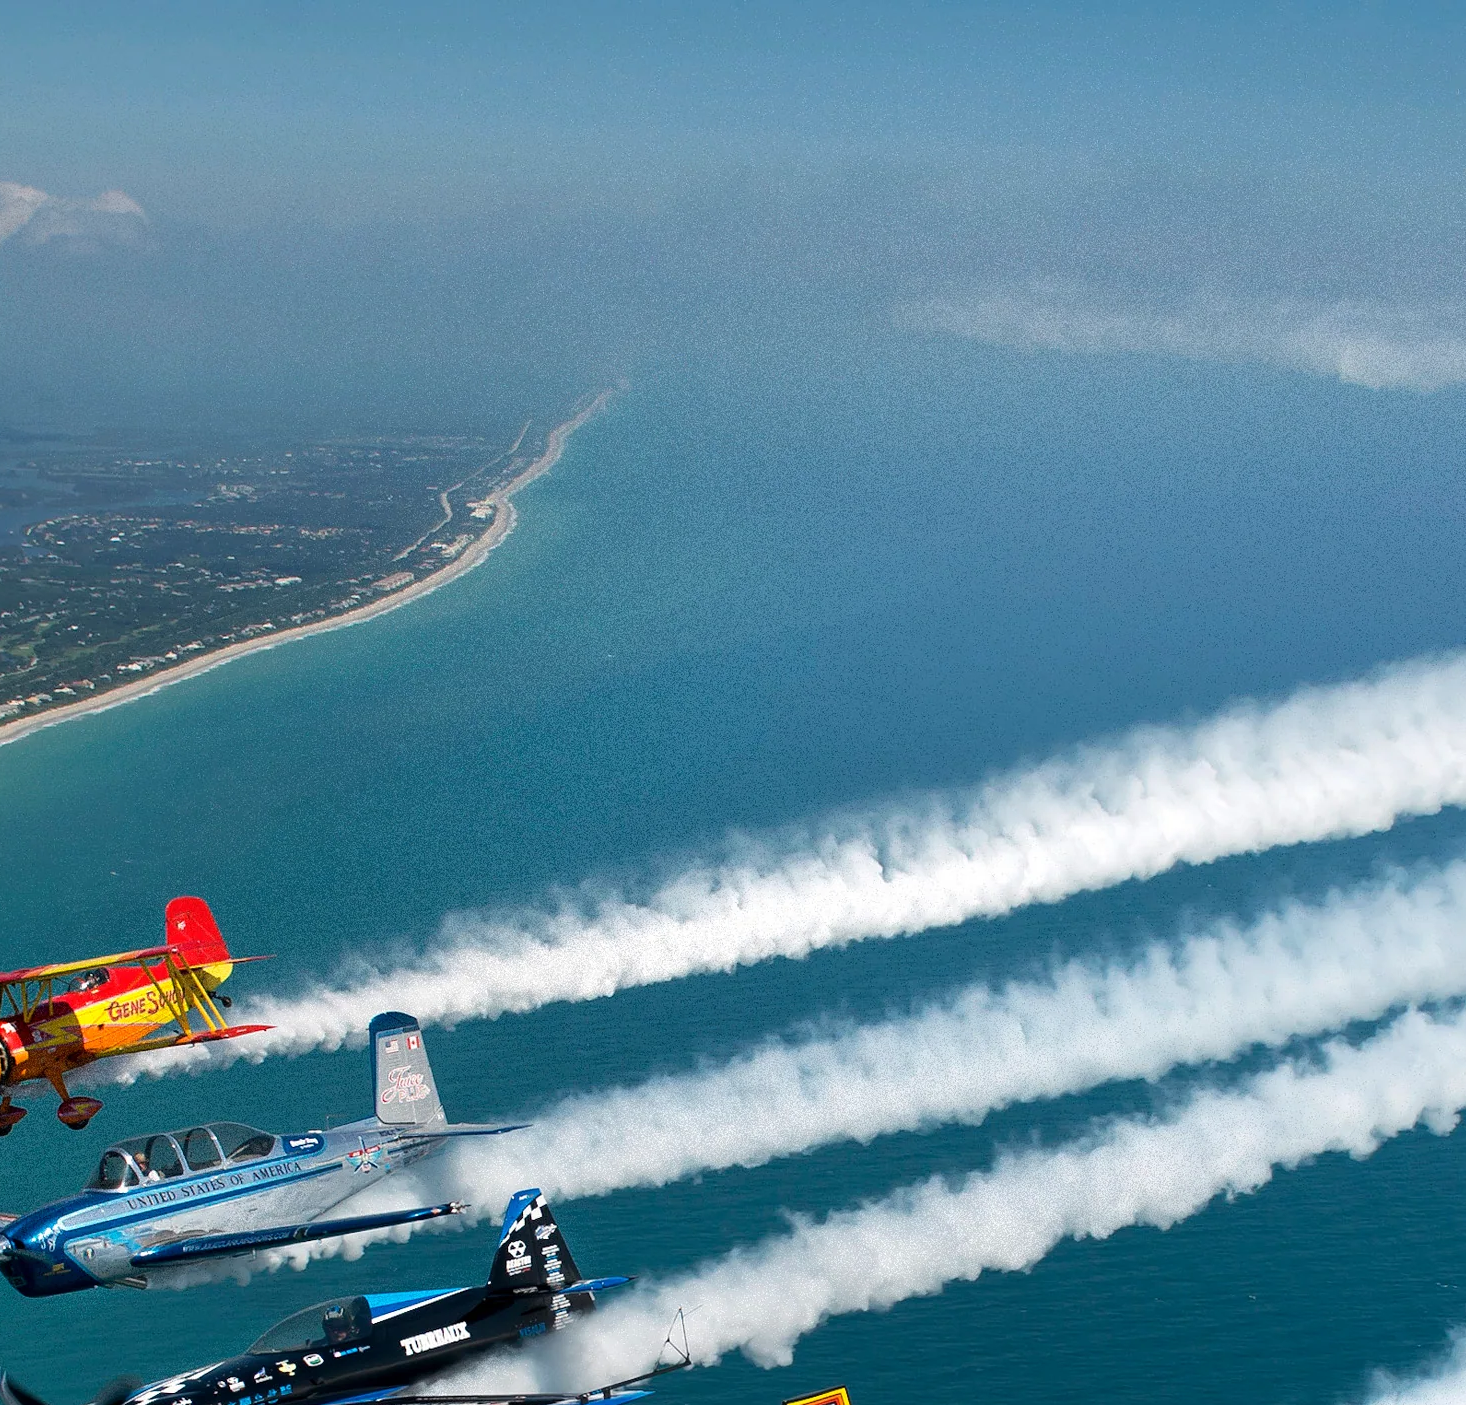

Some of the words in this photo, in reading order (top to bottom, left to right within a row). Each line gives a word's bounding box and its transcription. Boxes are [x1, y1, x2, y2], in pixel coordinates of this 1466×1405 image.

[107, 997, 146, 1022] GENE
[127, 1190, 177, 1210] UNITED
[181, 1179, 226, 1197] STATES
[229, 1173, 245, 1186] OF
[252, 1161, 303, 1182] AMERICA
